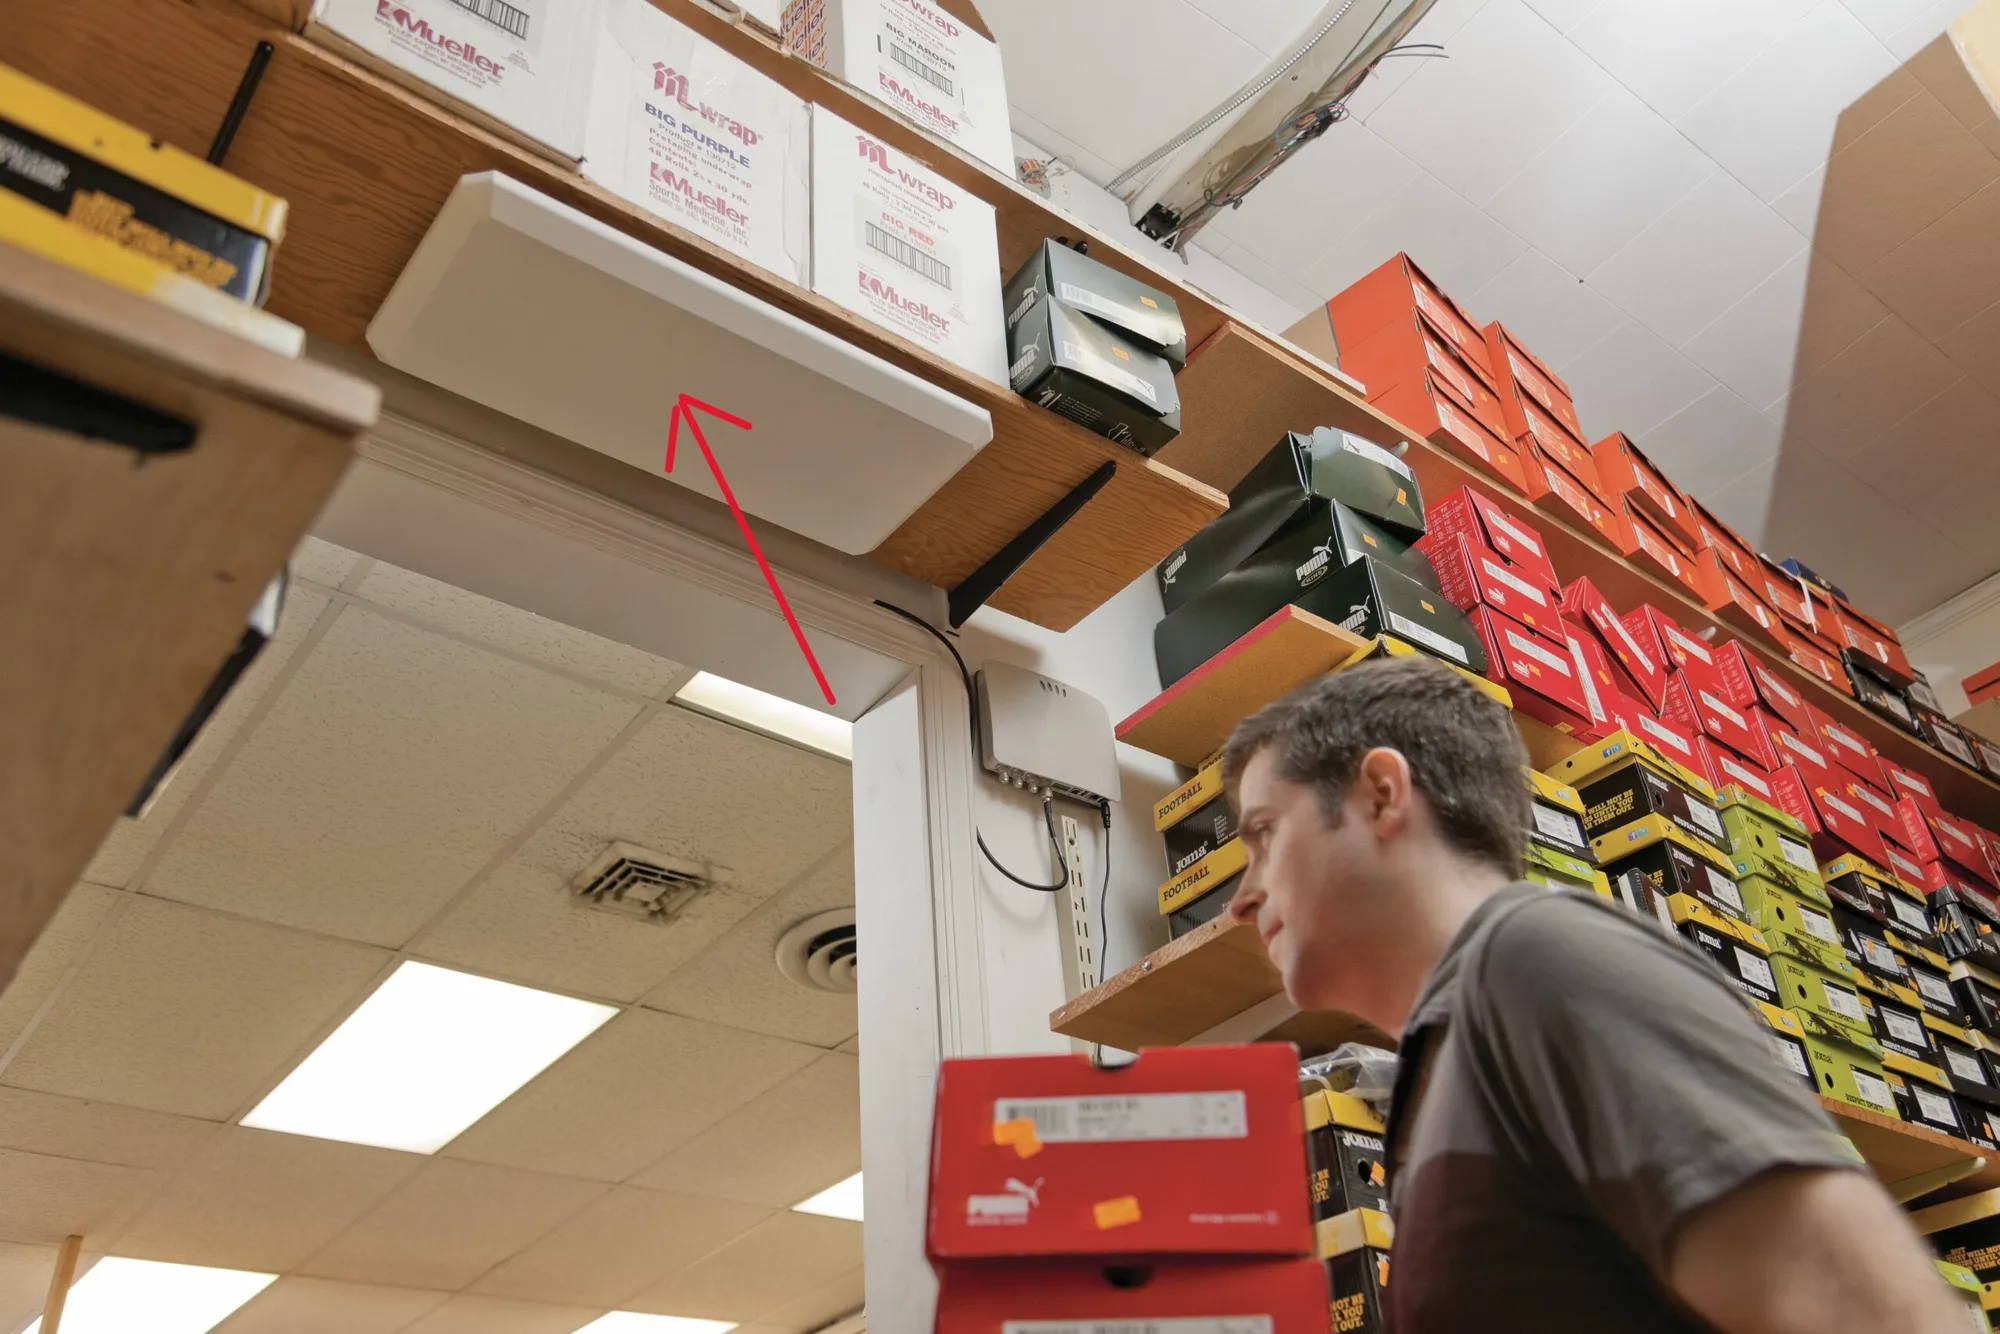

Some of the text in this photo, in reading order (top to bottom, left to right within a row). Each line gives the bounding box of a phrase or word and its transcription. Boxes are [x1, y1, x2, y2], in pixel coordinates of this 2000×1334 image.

[911, 0, 959, 37] wrap
[393, 8, 505, 78] Mueller
[886, 22, 955, 71] BIG MAROON
[889, 79, 959, 130] Mueller
[645, 102, 750, 169] BIG PURPLE
[658, 123, 694, 147] Product
[699, 101, 757, 146] wrap
[649, 127, 752, 189] Pretaping underwrap
[649, 179, 681, 204] Sports
[684, 198, 729, 231] Medicine,
[662, 169, 749, 227] Mueller
[897, 167, 954, 210] wrap
[881, 211, 934, 246] BIG RED
[870, 278, 950, 332] Mueller
[1008, 291, 1035, 330] PUMA
[1295, 549, 1329, 581] PUMA
[1158, 782, 1202, 819] FOOTBALL
[1588, 788, 1634, 815] WILL NOT BE
[1594, 803, 1617, 819] UNTIL
[1616, 796, 1634, 809] YOU
[1594, 813, 1617, 829] THEM
[1617, 805, 1635, 818] OUT.
[1163, 865, 1210, 902] FOOTBALL
[1748, 984, 1770, 1001] SPORTS
[1966, 1249, 1986, 1259] WILL
[1973, 1253, 1998, 1264] UNTIL
[1973, 1260, 1997, 1271] THEM
[1342, 1304, 1364, 1319] YOU
[1351, 1292, 1365, 1304] BE
[1340, 1316, 1364, 1332] OUT.
